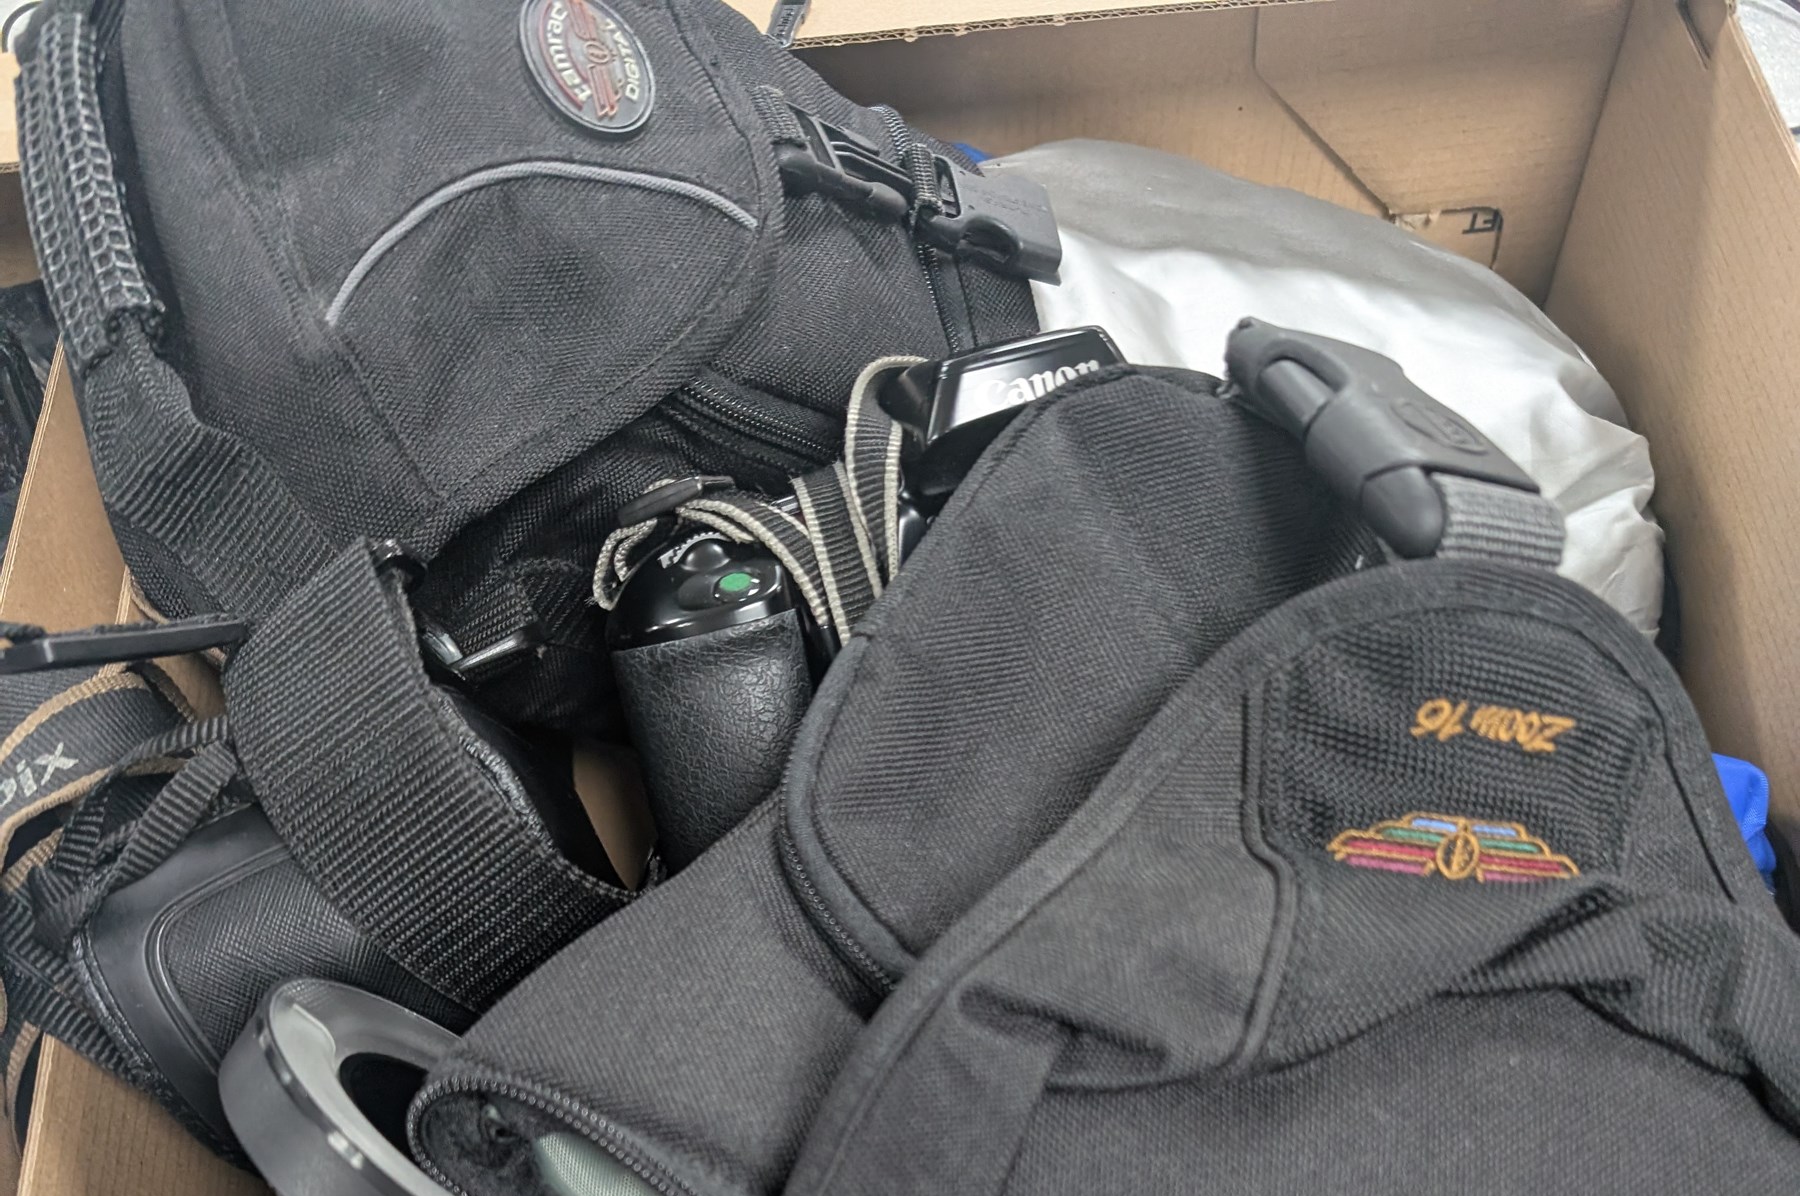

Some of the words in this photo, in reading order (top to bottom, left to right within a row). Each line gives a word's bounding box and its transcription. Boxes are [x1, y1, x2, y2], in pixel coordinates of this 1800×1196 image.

[546, 2, 593, 102] tamrac
[602, 18, 641, 101] DIGITAL
[1409, 698, 1469, 743] 16
